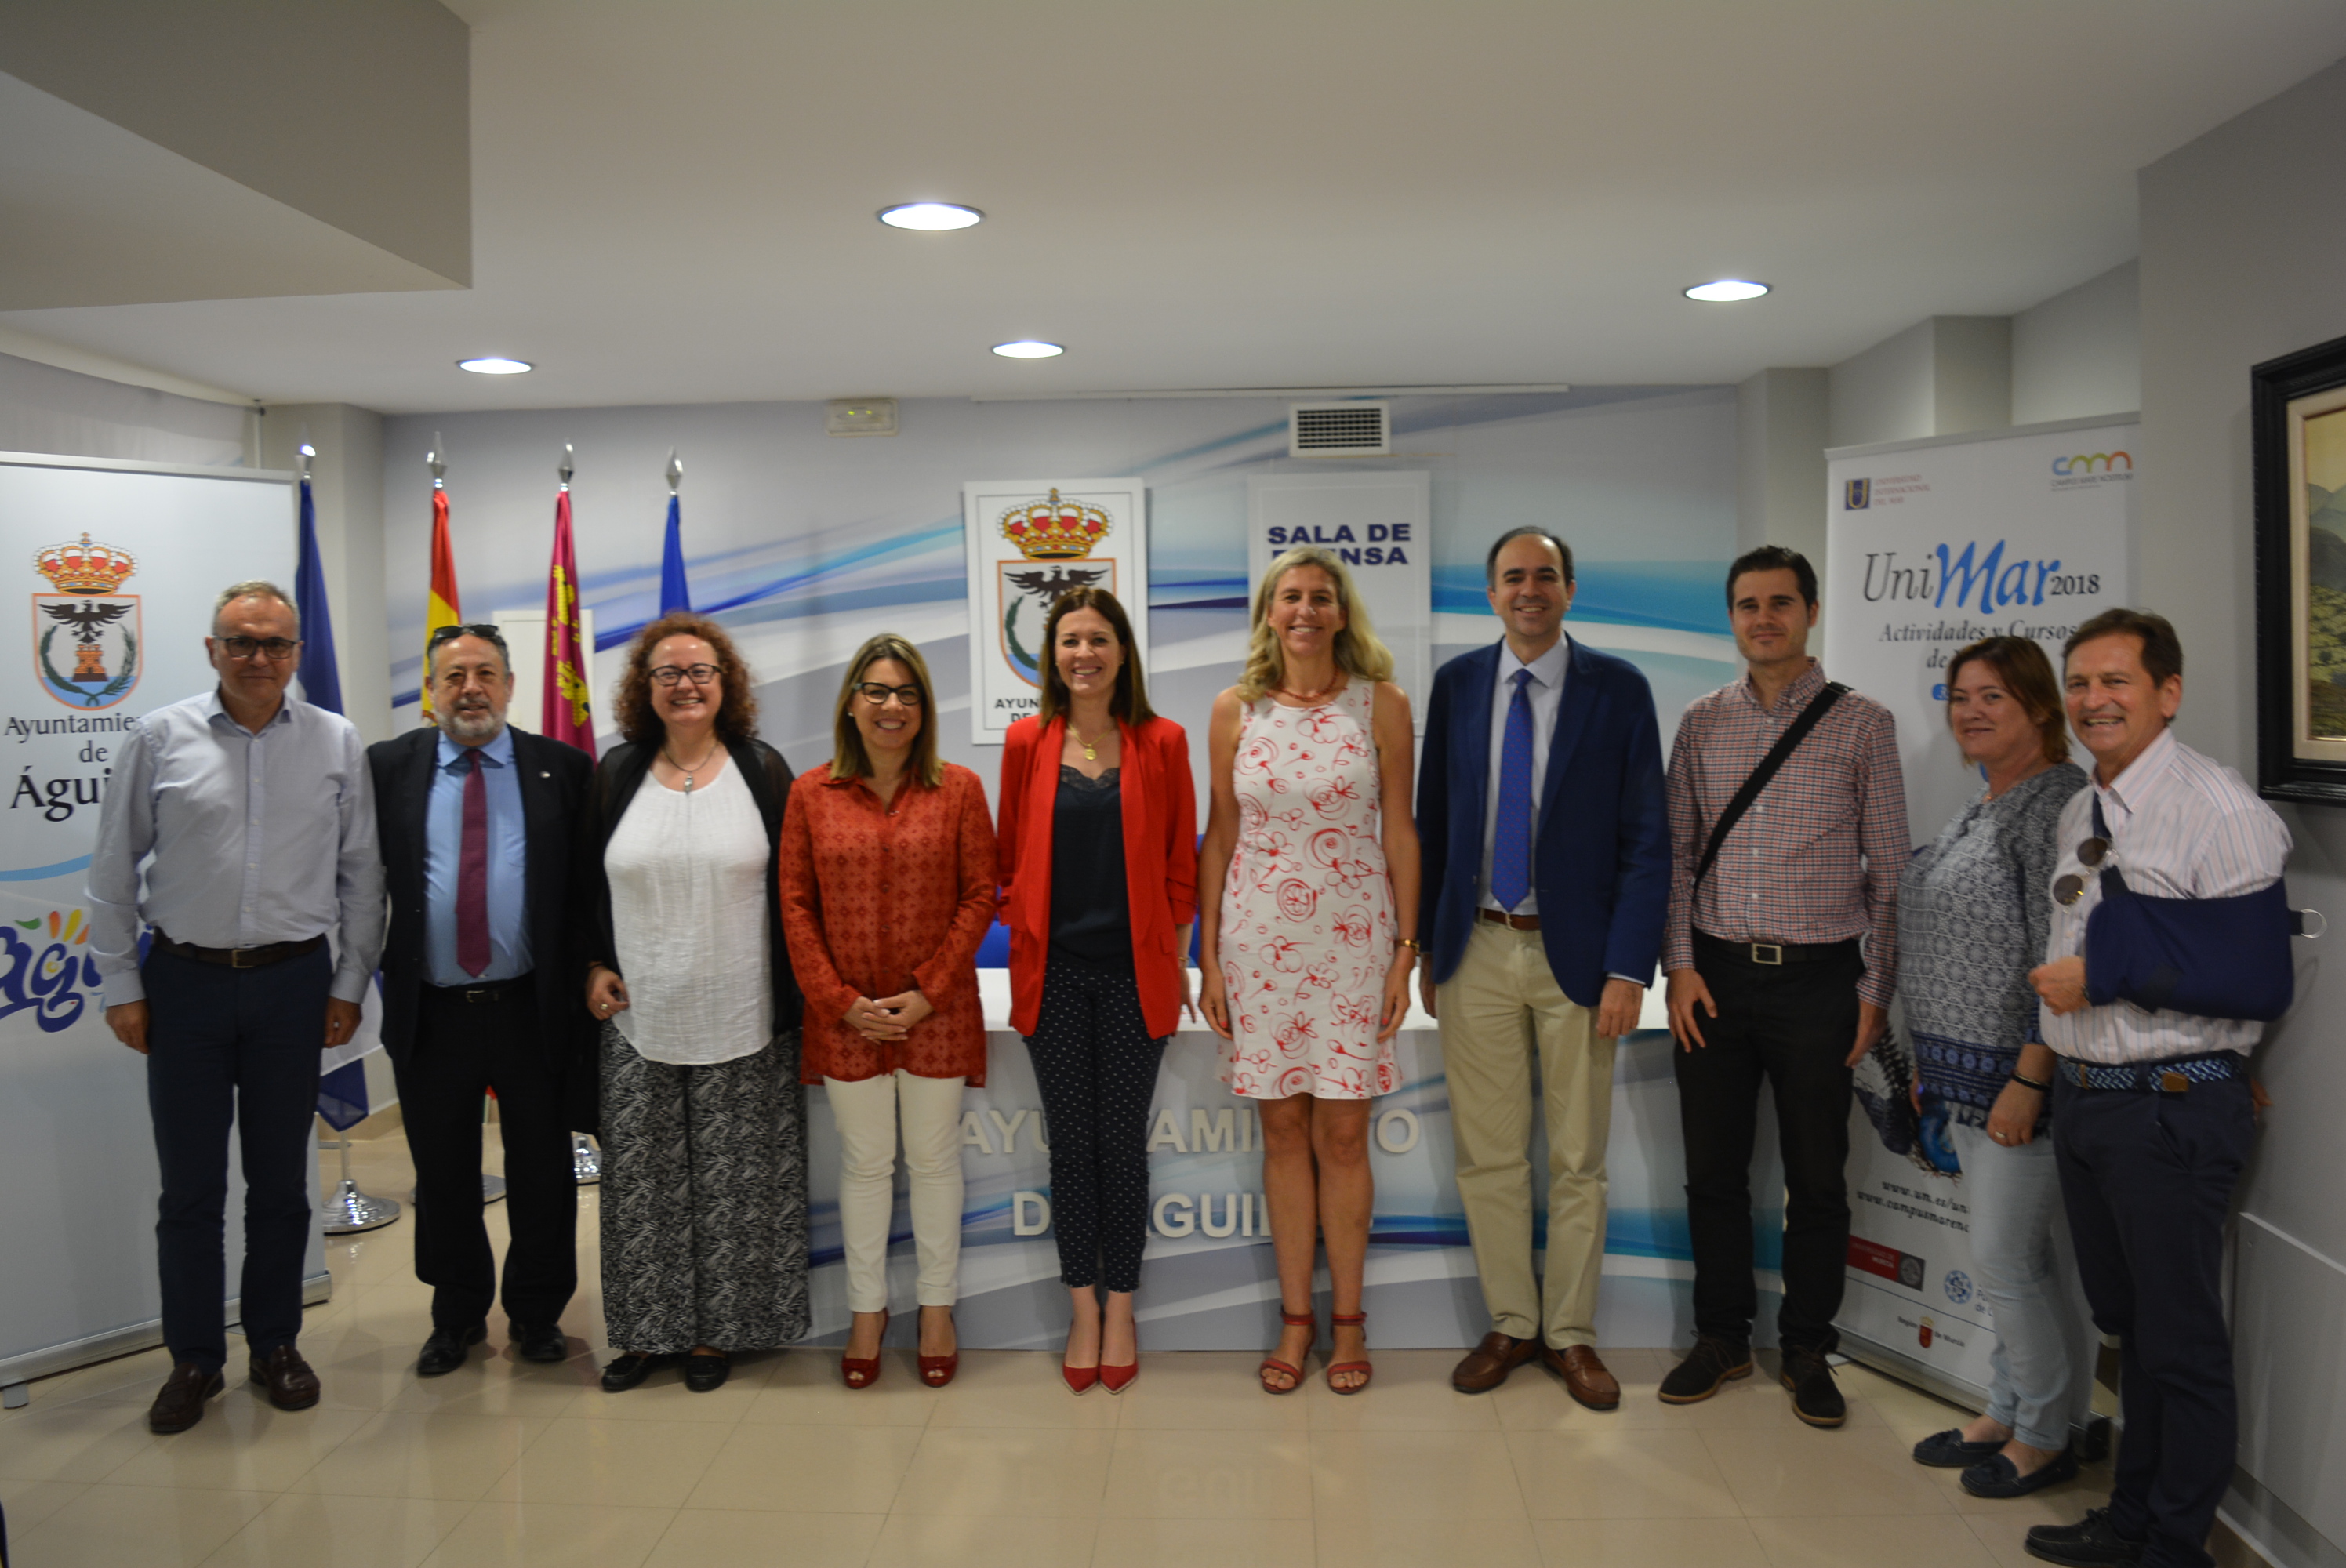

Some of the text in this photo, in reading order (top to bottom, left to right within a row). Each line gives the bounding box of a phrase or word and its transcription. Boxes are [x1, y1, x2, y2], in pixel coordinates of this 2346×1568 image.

[1268, 523, 1411, 544] SALA DE
[2050, 574, 2101, 595] 2018
[1879, 620, 1986, 642] Actividades
[2009, 619, 2079, 641] Cursos
[1926, 648, 1948, 668] de
[4, 713, 142, 743] Ayuntamie
[79, 740, 108, 763] de
